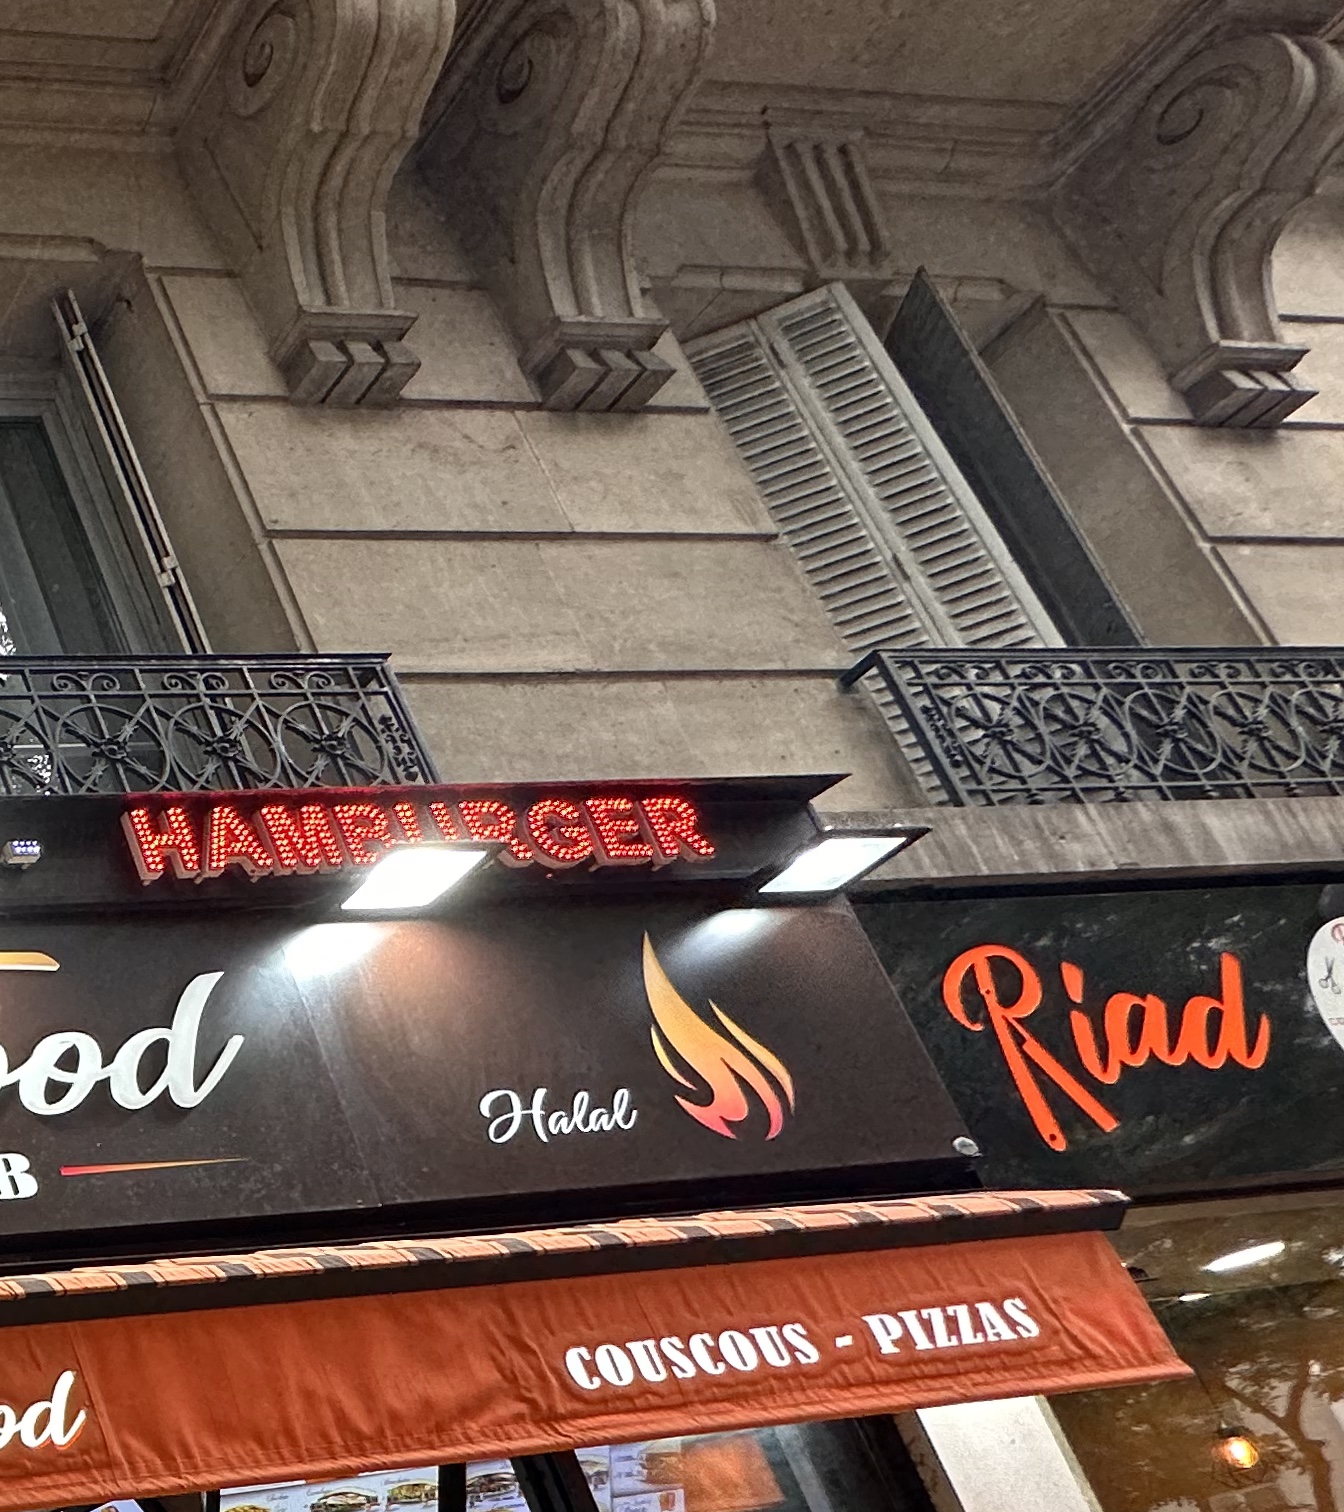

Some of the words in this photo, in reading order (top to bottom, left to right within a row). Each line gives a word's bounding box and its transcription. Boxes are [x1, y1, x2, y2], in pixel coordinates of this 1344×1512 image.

[942, 943, 1270, 1154] Riad
[479, 1086, 639, 1144] Halal
[565, 1324, 819, 1392] COUSCOUS
[862, 1298, 1041, 1356] PIZZAS
